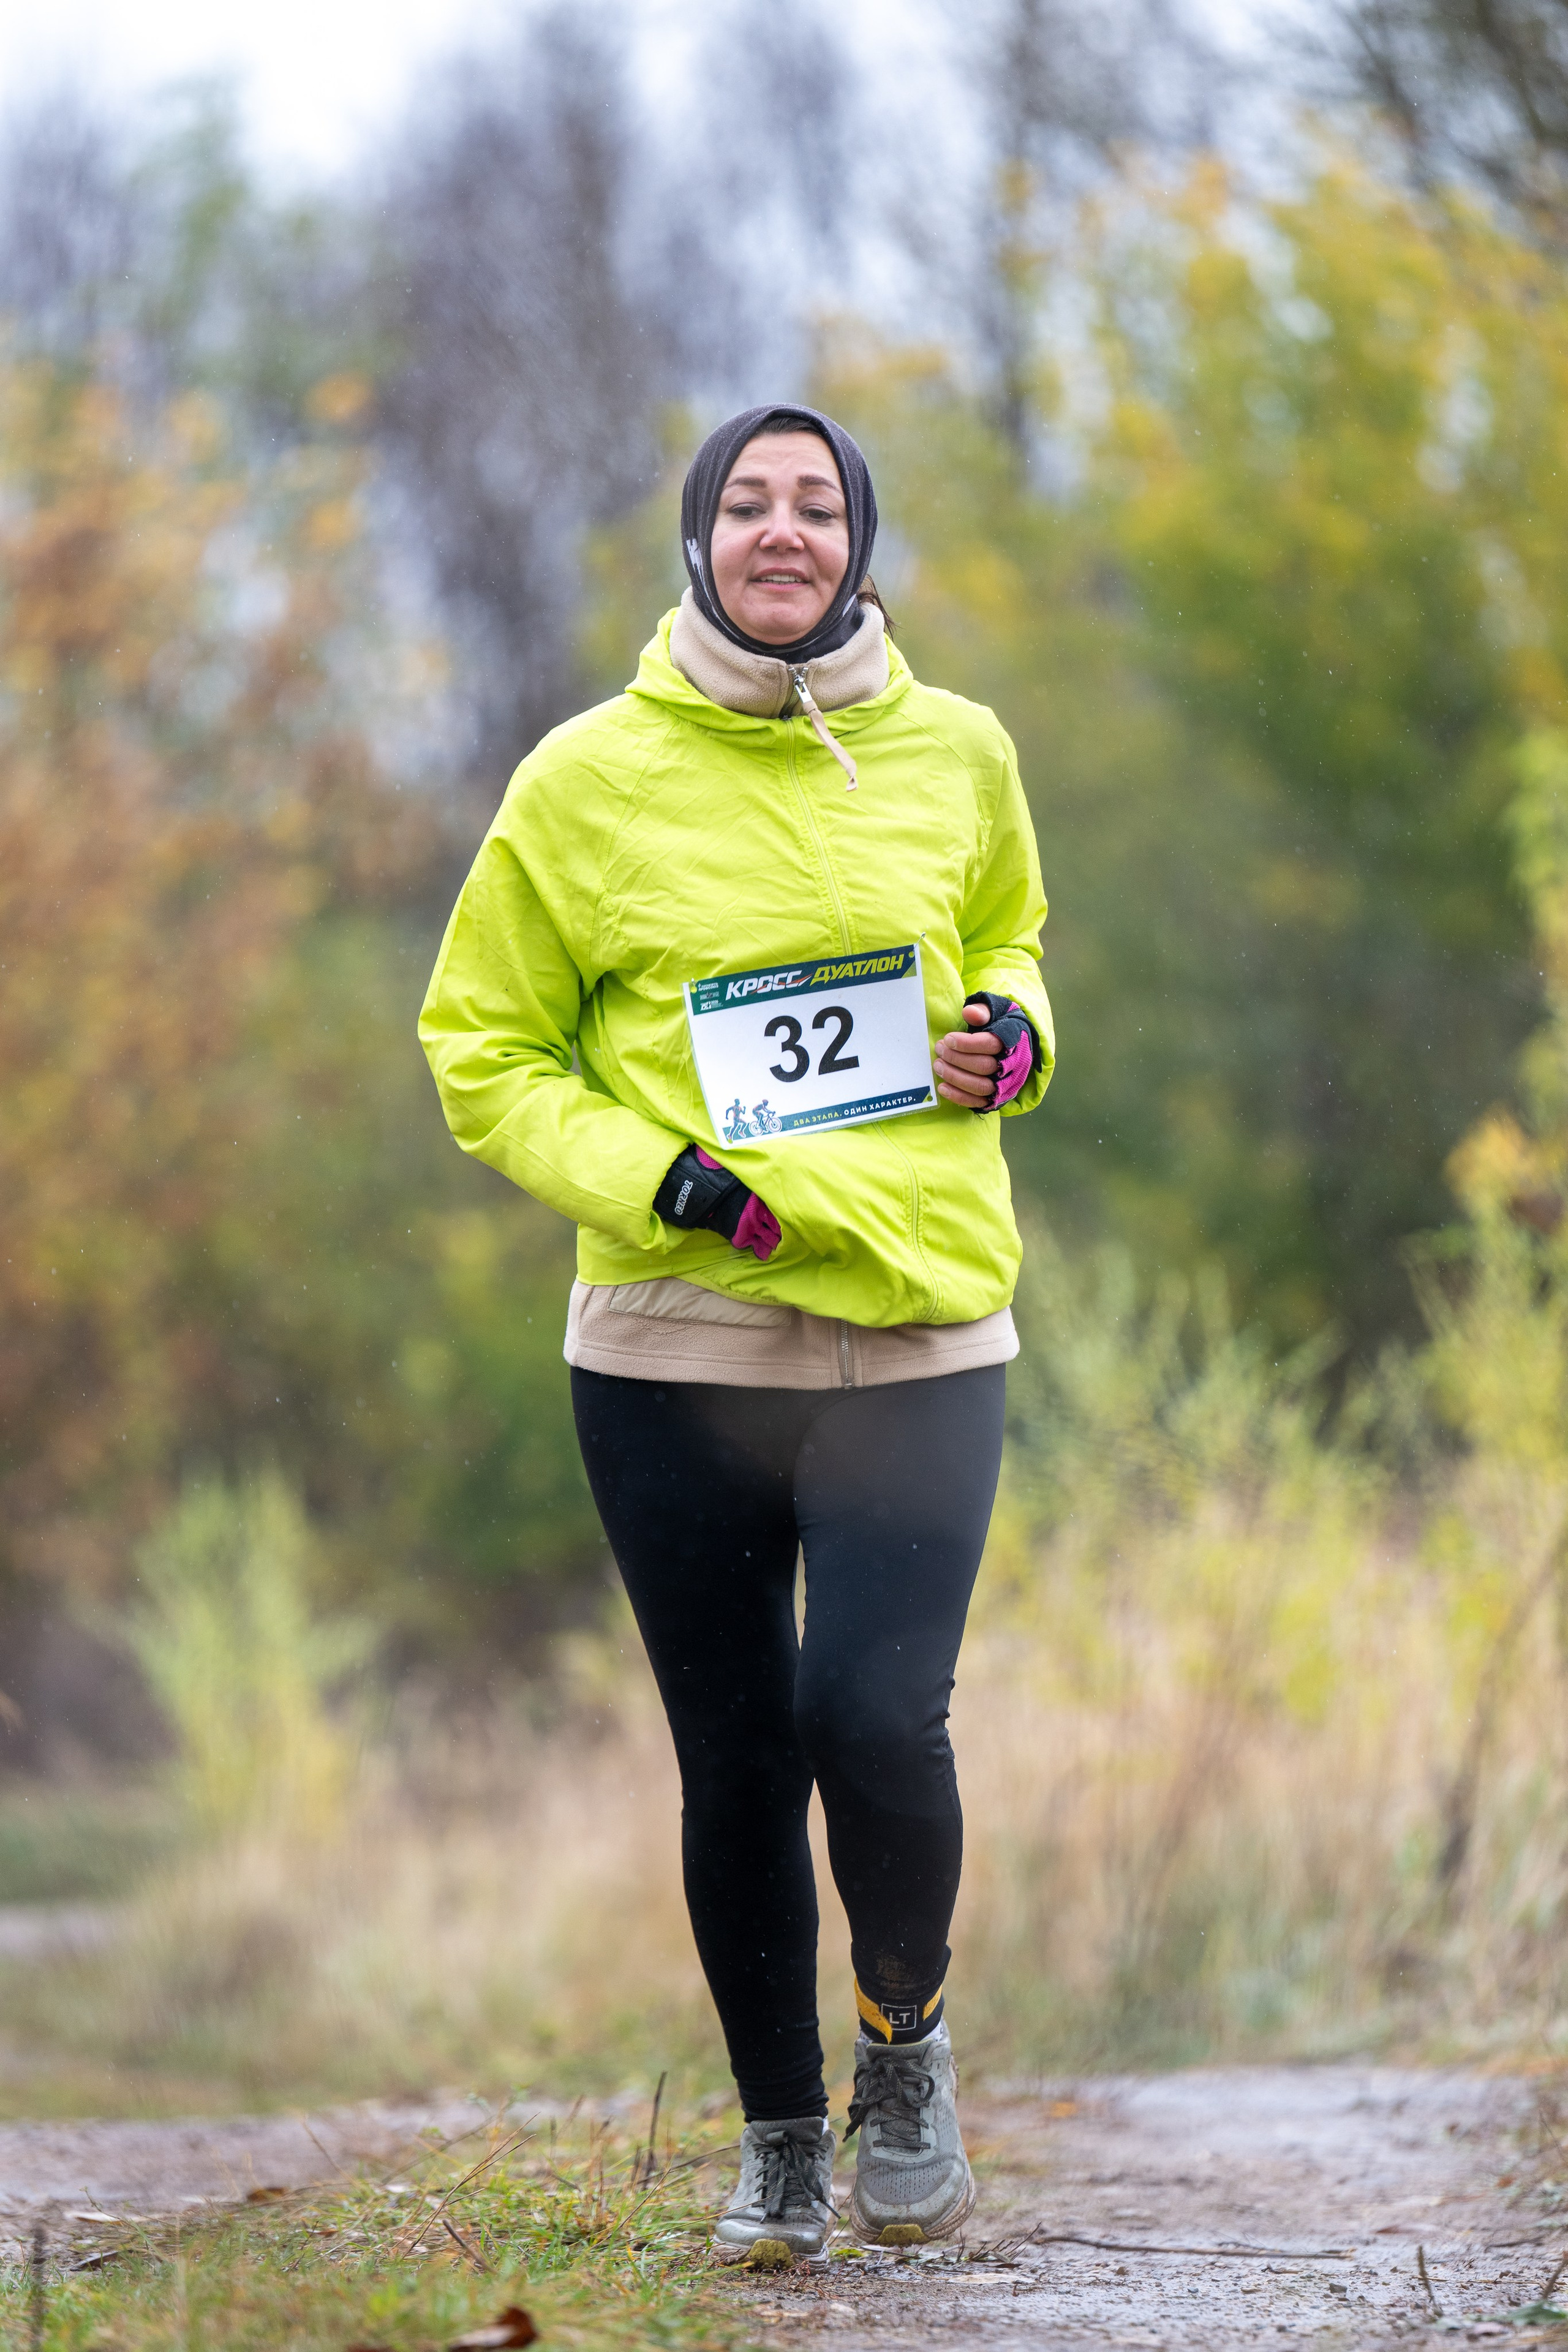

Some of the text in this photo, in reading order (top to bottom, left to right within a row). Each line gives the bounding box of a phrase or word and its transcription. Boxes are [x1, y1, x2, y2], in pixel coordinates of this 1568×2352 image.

[725, 954, 905, 1001] КРОСС ДУАТЛОН
[764, 1006, 859, 1082] 32
[793, 1117, 810, 1127] ДВА
[843, 1105, 867, 1116] ОДИН
[869, 1096, 916, 1110] ХАРАКТЕР.
[674, 1180, 693, 1215] TORNEO
[889, 2012, 911, 2024] LT
